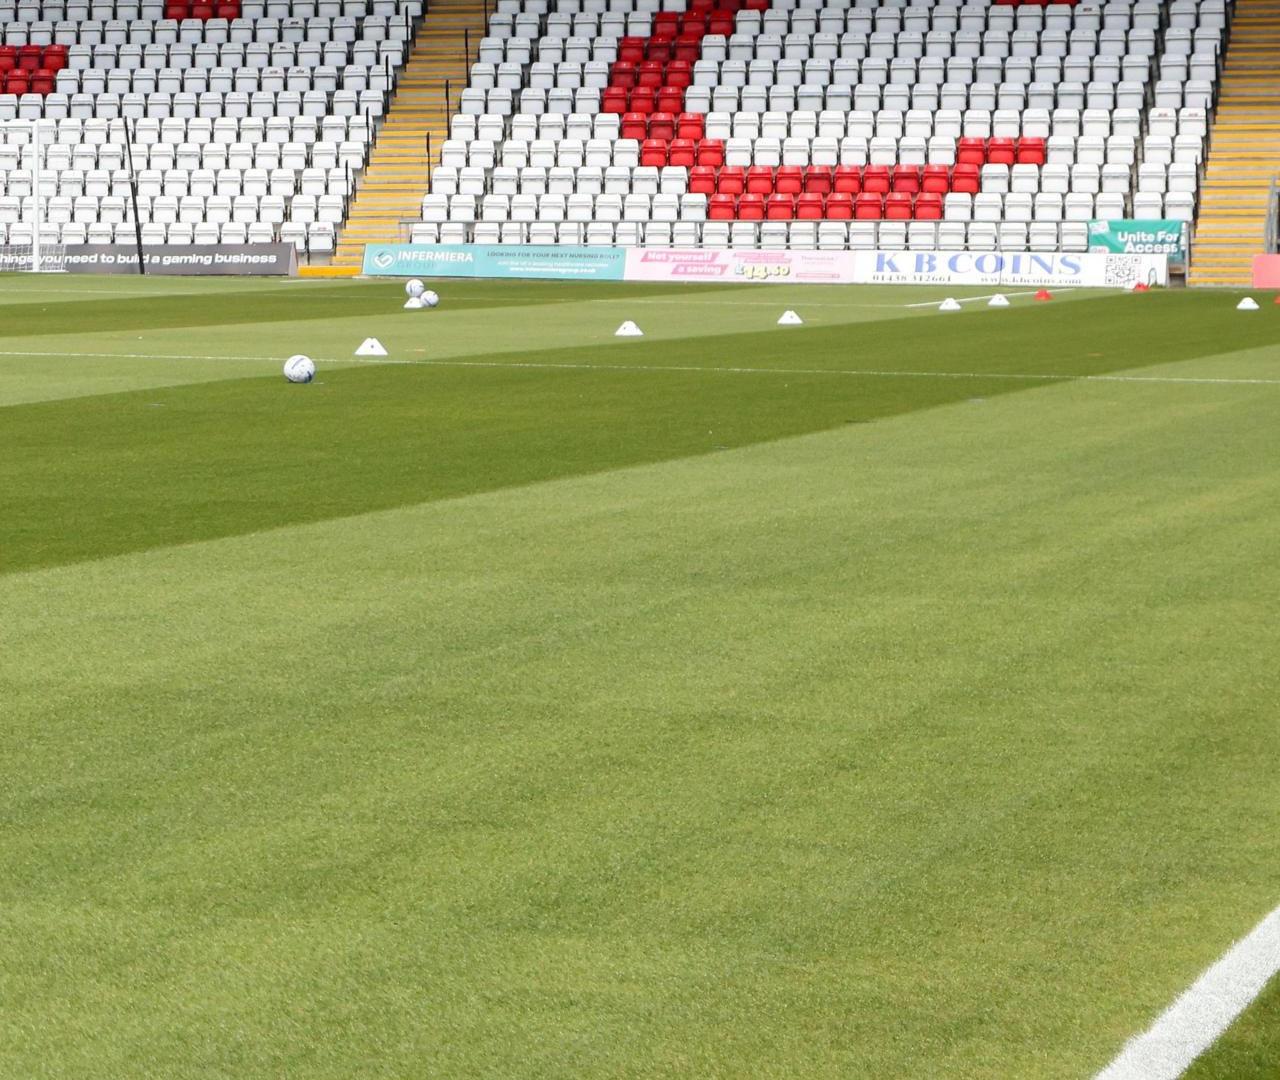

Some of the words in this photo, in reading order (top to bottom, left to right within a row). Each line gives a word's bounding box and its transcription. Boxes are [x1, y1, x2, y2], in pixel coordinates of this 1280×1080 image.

[1117, 231, 1155, 243] Unite
[1156, 231, 1180, 243] For
[1123, 242, 1179, 254] Access
[39, 256, 64, 266] you
[64, 254, 99, 264] need
[100, 254, 115, 264] to
[151, 255, 160, 264] a
[162, 253, 213, 266] gaming
[214, 253, 277, 264] business
[397, 251, 474, 263] INFERMIERA
[875, 253, 900, 273] K
[914, 253, 937, 274] B
[947, 253, 1082, 275] COINS
